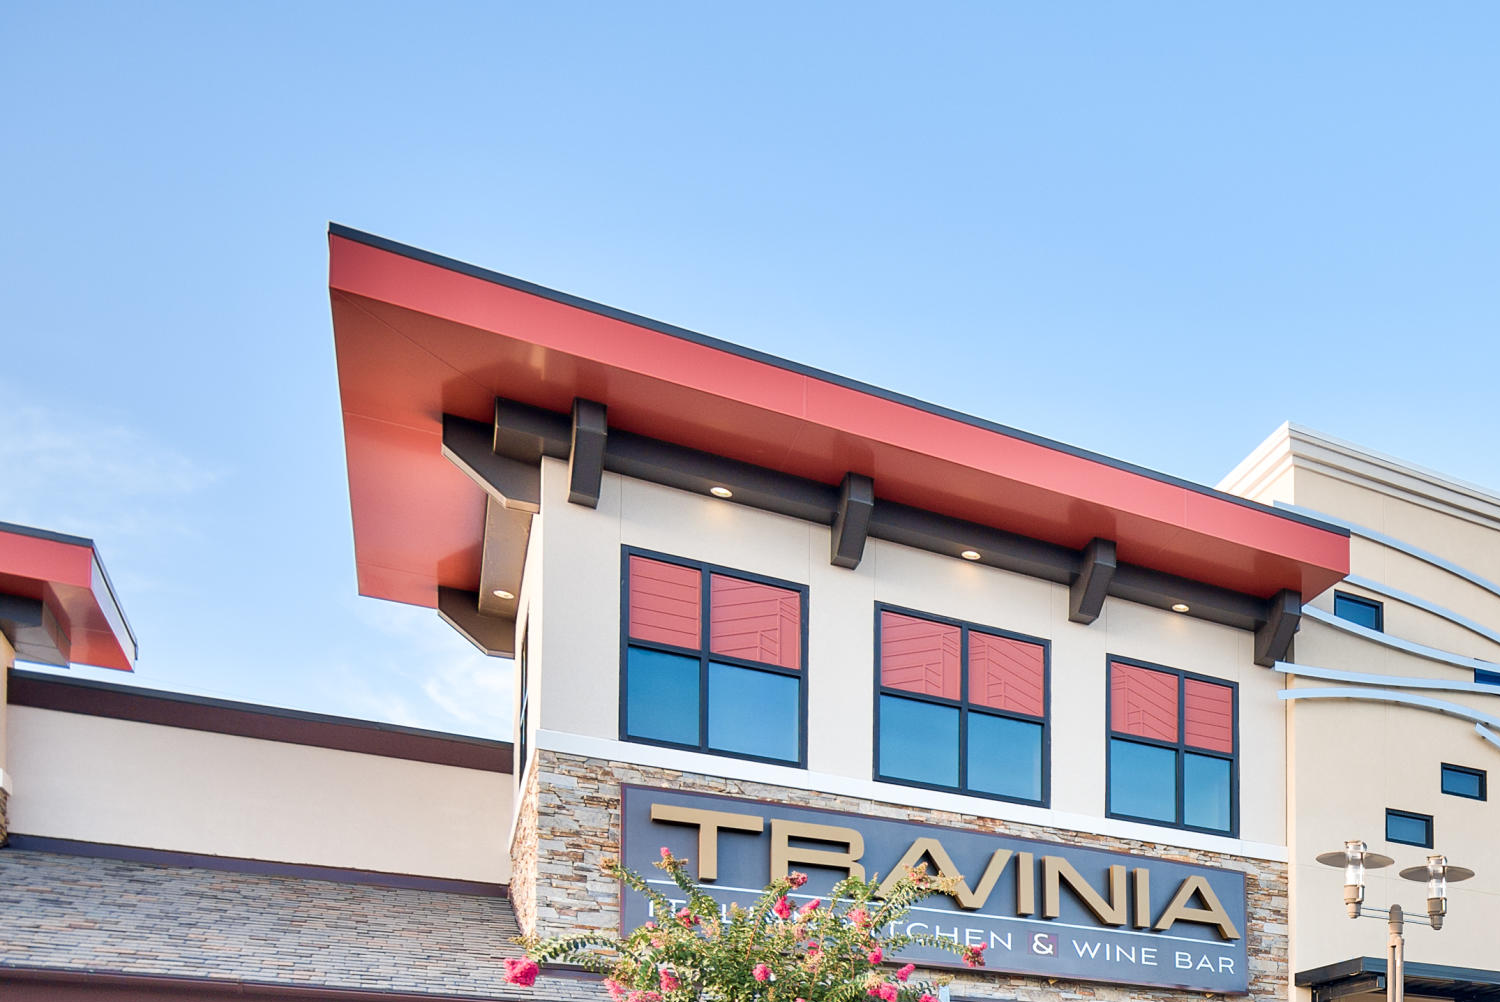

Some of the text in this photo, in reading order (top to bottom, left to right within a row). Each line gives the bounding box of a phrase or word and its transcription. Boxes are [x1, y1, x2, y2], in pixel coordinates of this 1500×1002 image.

[650, 804, 1241, 941] TRAVINIA
[838, 916, 1012, 950] TCHEN
[1032, 933, 1054, 955] &
[1072, 939, 1158, 966] WINE
[1175, 951, 1235, 975] BAR
